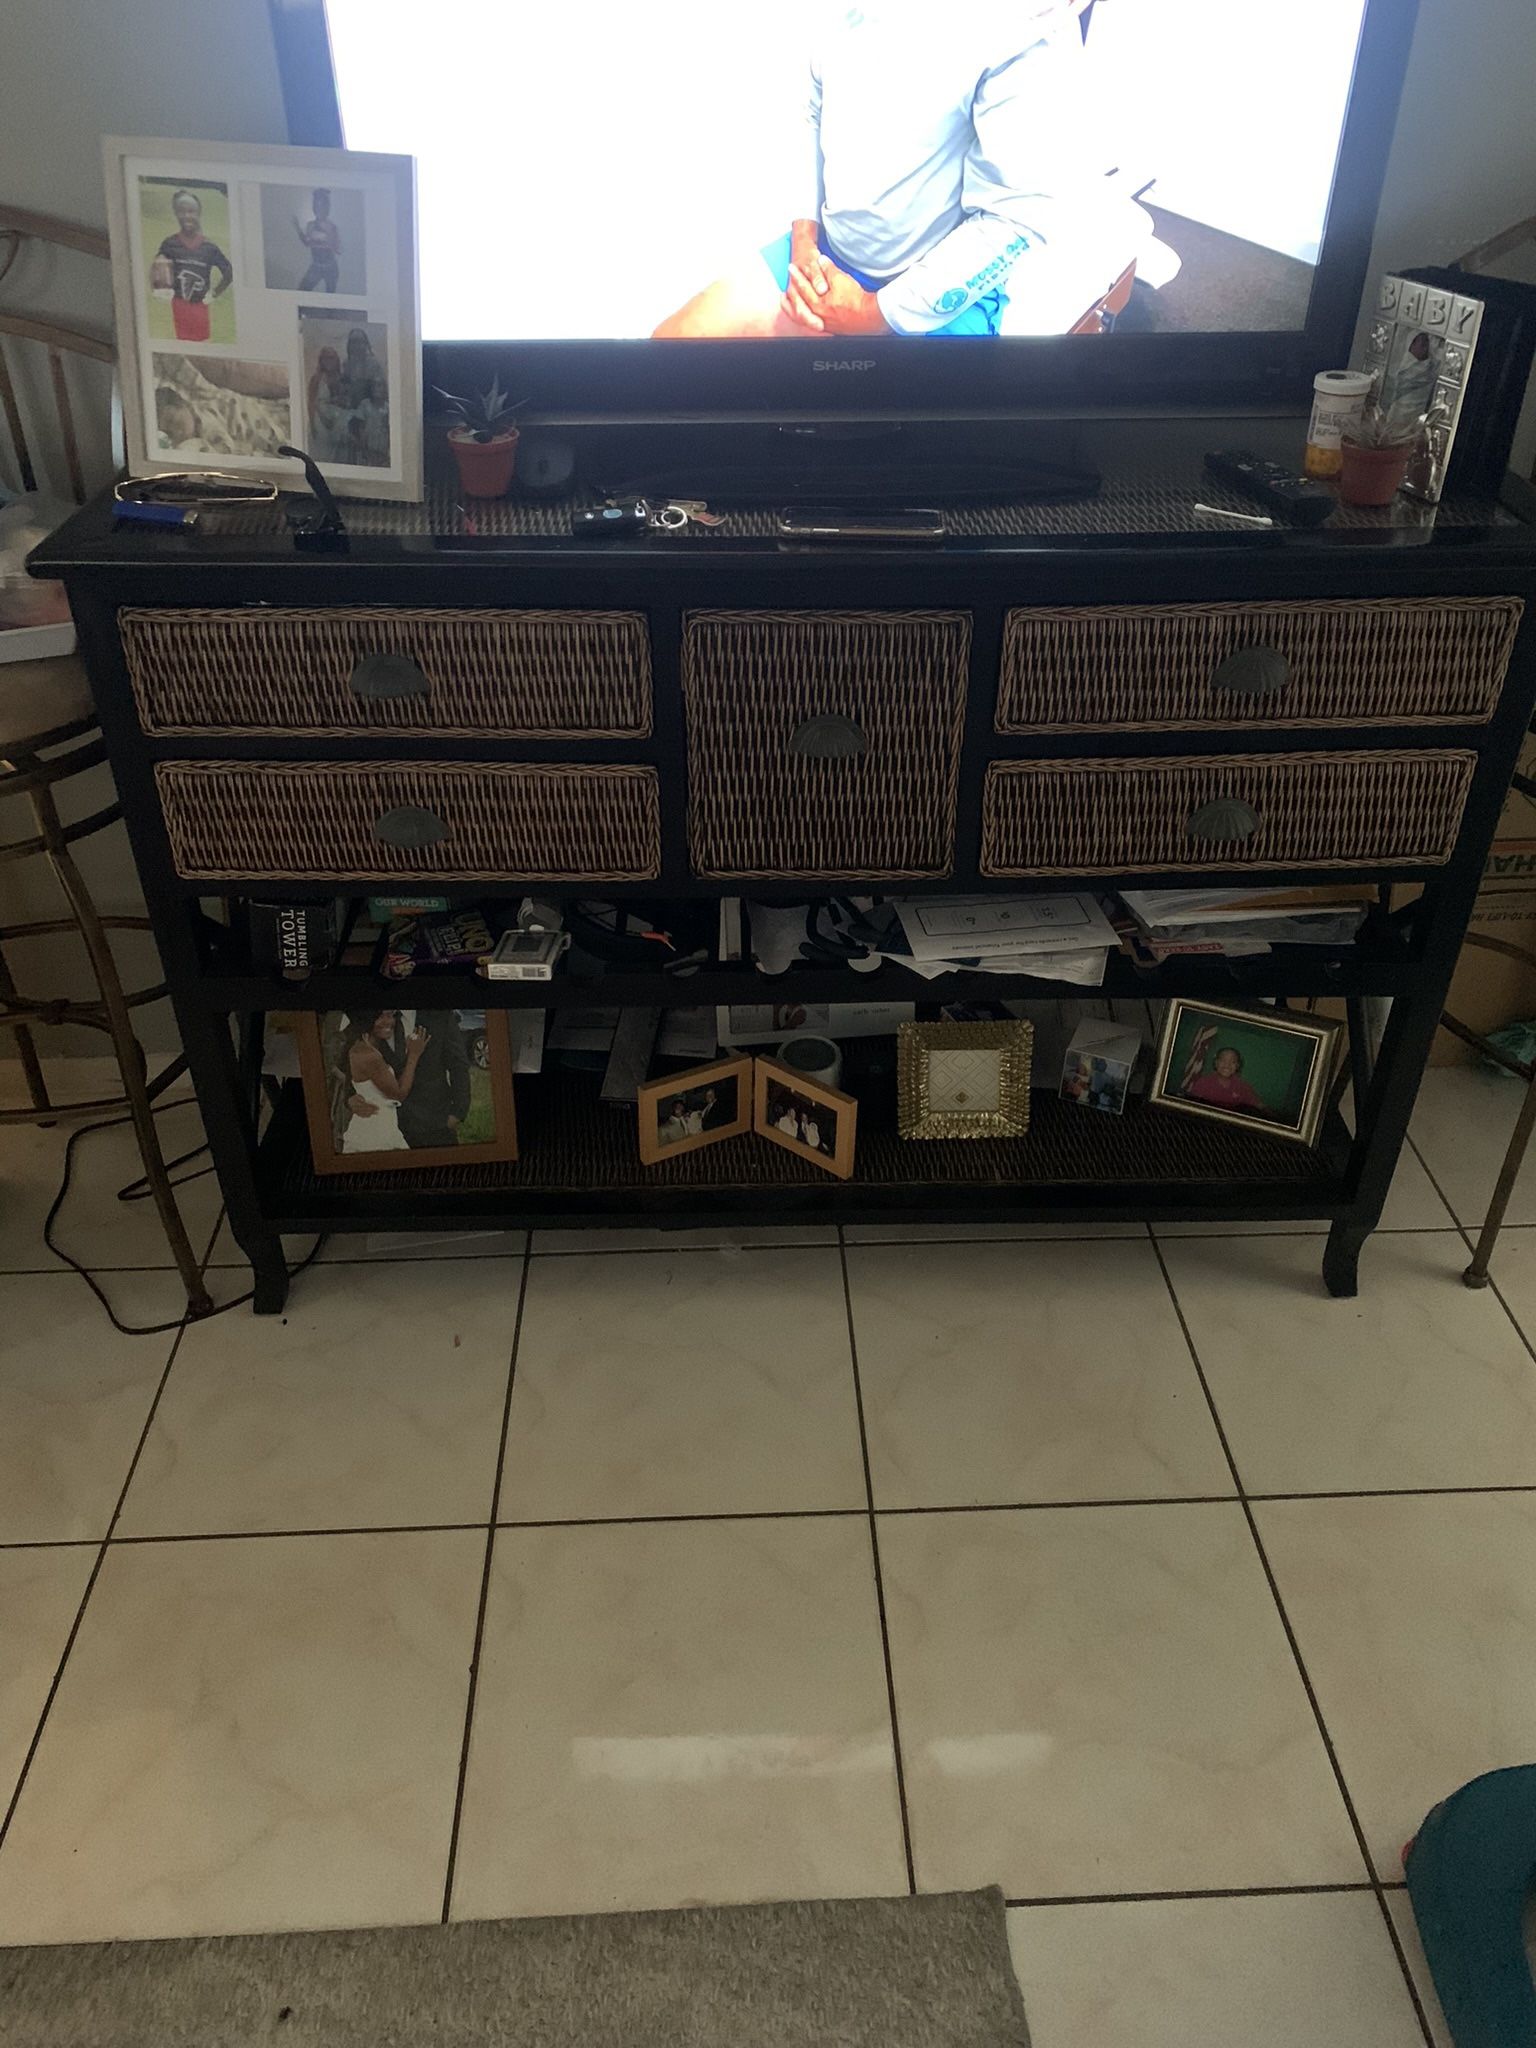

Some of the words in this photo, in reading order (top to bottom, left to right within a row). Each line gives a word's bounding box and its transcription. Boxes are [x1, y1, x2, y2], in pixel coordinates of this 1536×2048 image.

[1379, 283, 1474, 334] BABY
[813, 360, 877, 371] SHARP
[374, 898, 399, 907] OUR
[399, 897, 439, 908] WORLD
[281, 909, 298, 968] TOWER
[296, 909, 309, 967] TUMBLING
[453, 911, 495, 952] UNO
